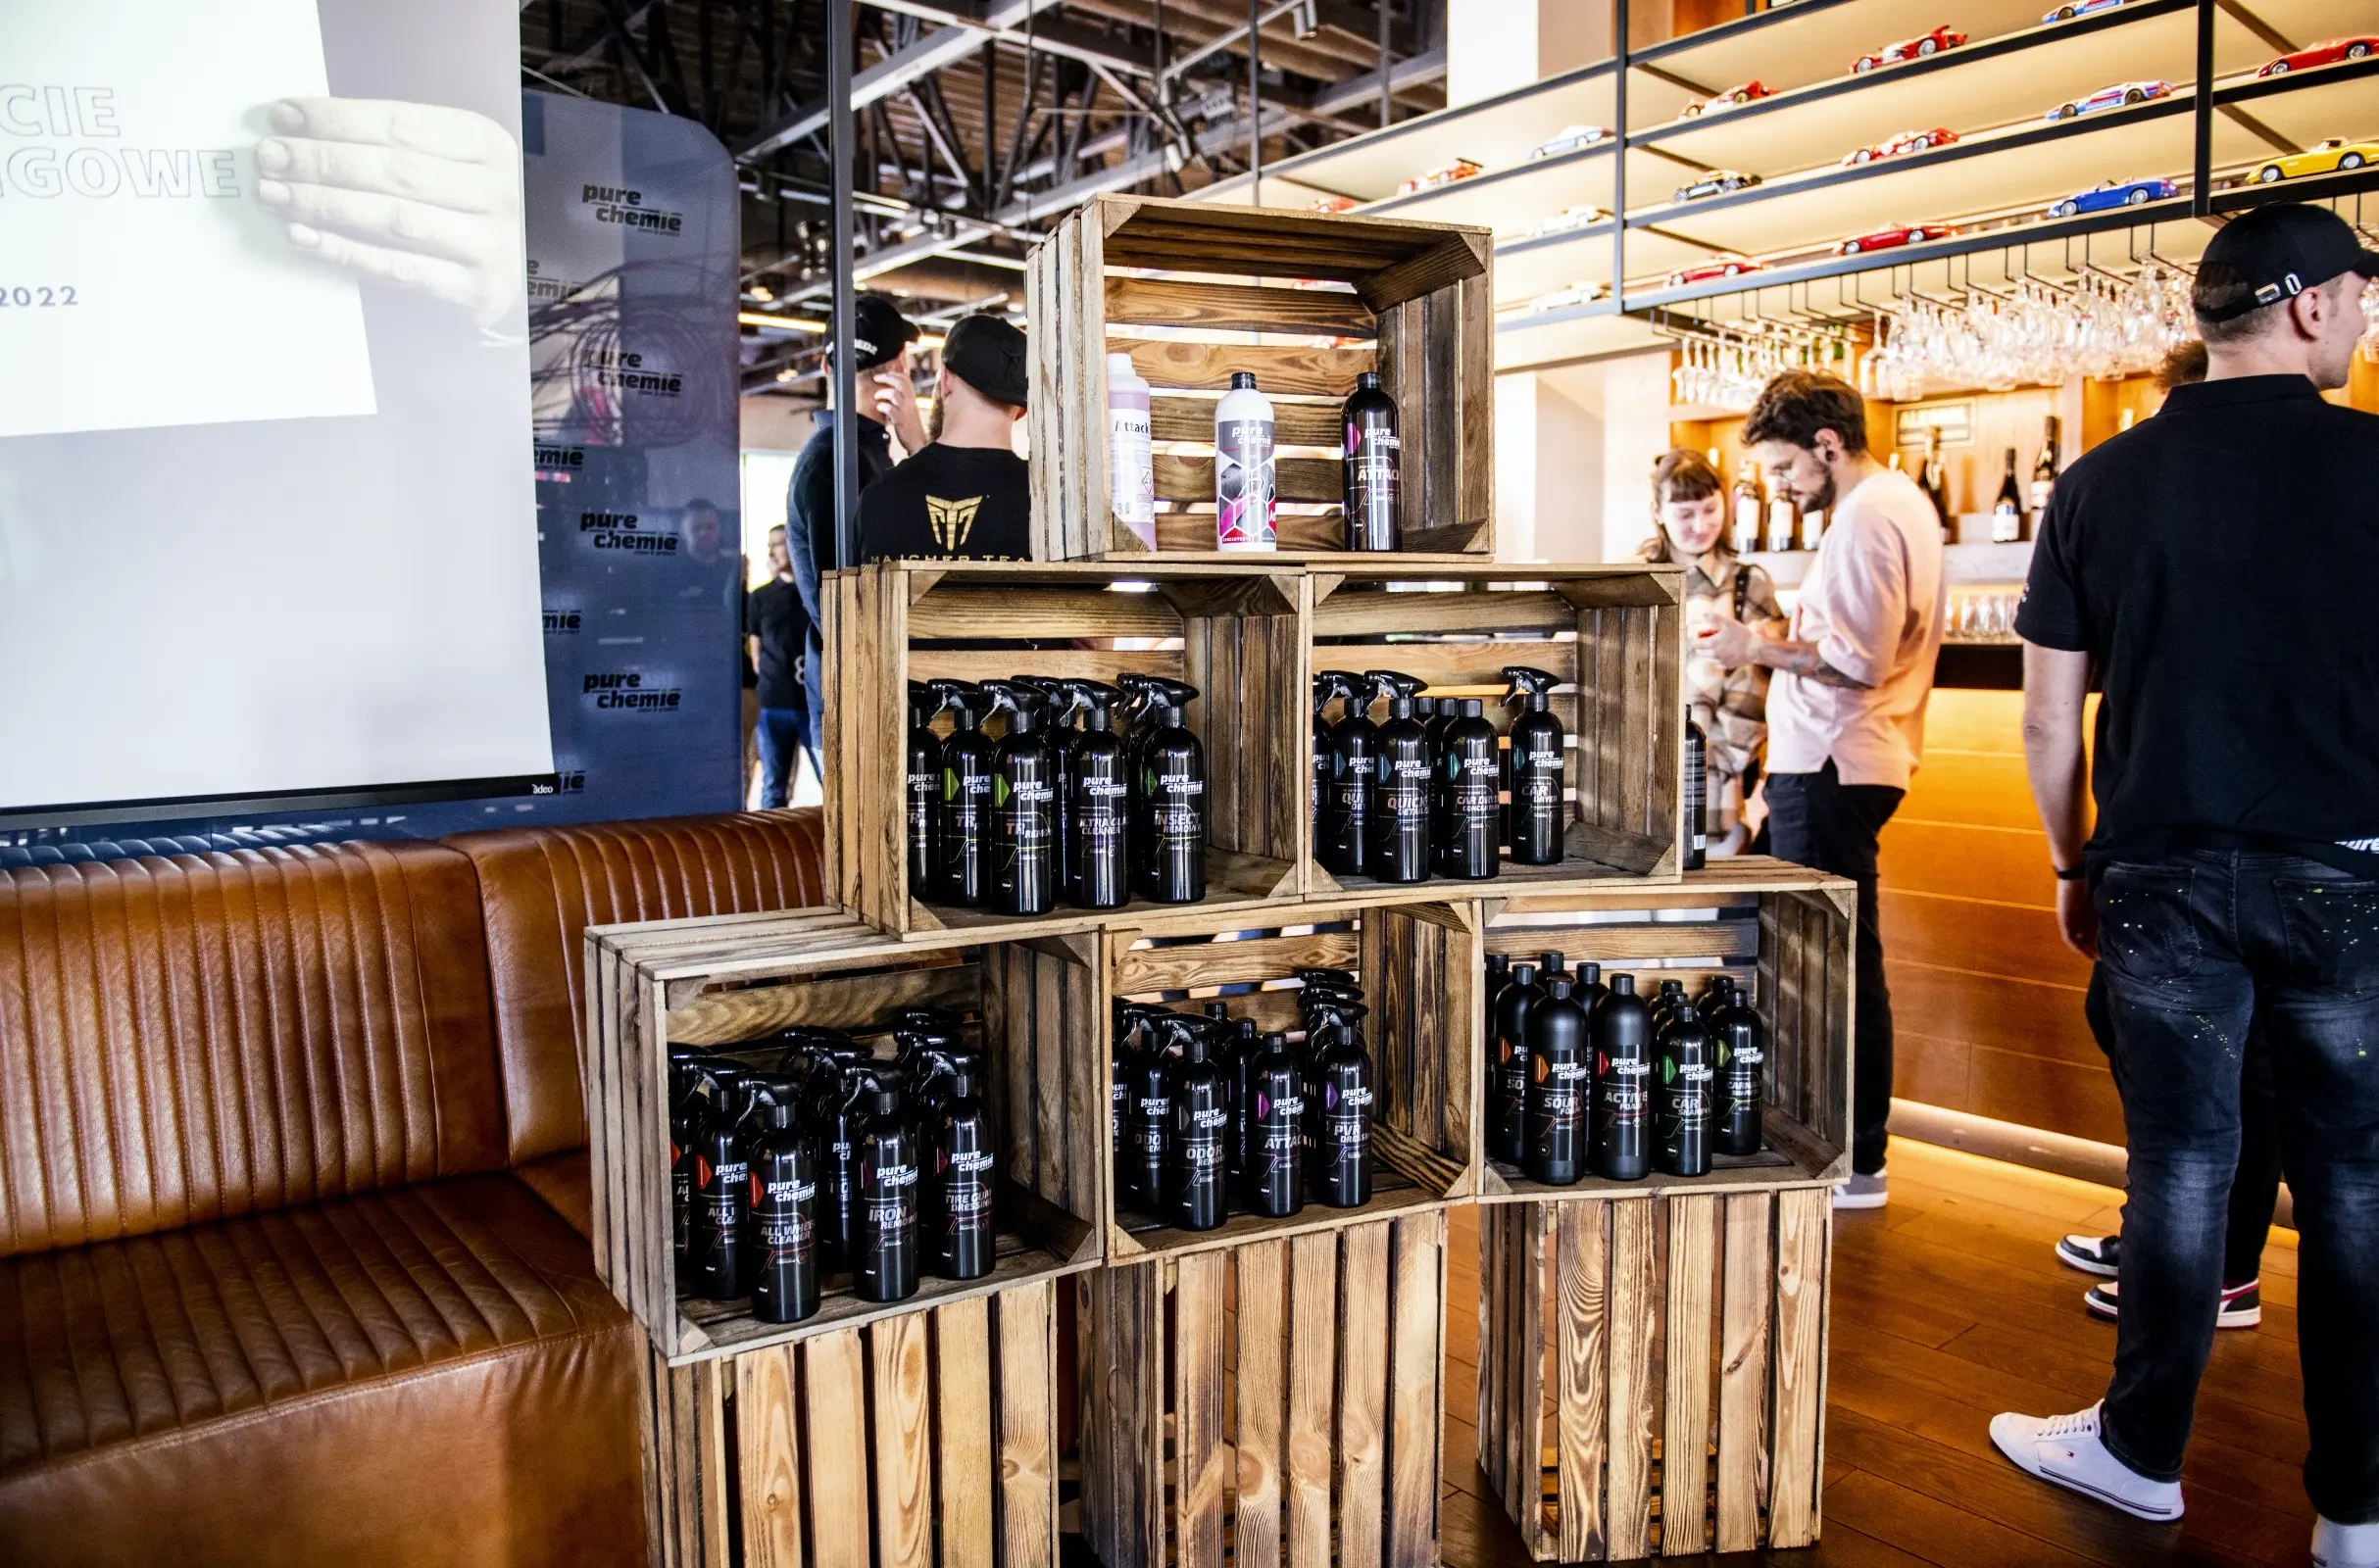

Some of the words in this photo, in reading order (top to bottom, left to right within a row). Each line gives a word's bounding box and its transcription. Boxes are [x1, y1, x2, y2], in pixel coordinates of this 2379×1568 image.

[0, 147, 241, 198] GOWE
[582, 184, 641, 205] pure
[596, 205, 681, 231] chemie
[1115, 420, 1149, 434] Attack
[1232, 426, 1263, 437] pure
[580, 513, 637, 530] pure
[594, 531, 677, 551] chemie
[583, 673, 641, 694] pure
[597, 689, 680, 709] chemie
[1529, 751, 1555, 760] pure
[1395, 760, 1421, 770] pure
[1464, 759, 1490, 767] pure
[963, 775, 990, 786] pure
[1083, 776, 1112, 787] pure
[1161, 774, 1189, 785] pure
[969, 784, 990, 794] che
[1013, 781, 1043, 793] pure
[1552, 1062, 1577, 1072] pure
[1611, 1057, 1639, 1066] pure
[1679, 1063, 1706, 1073] pure
[1342, 1087, 1366, 1099] pure
[1273, 1097, 1299, 1108] pure
[1671, 1098, 1699, 1108] CAR
[1194, 1108, 1219, 1121] pure
[1136, 1134, 1161, 1145] ODO
[1264, 1135, 1302, 1149] ATTAC
[952, 1151, 980, 1164] pure
[1186, 1145, 1222, 1159] ODOR
[716, 1162, 747, 1175] pure
[877, 1164, 907, 1179] pure
[768, 1180, 800, 1194] pure
[775, 1184, 816, 1202] chemie
[868, 1206, 907, 1222] IRON
[761, 1226, 781, 1237] ALL
[768, 1234, 812, 1245] CLEANER
